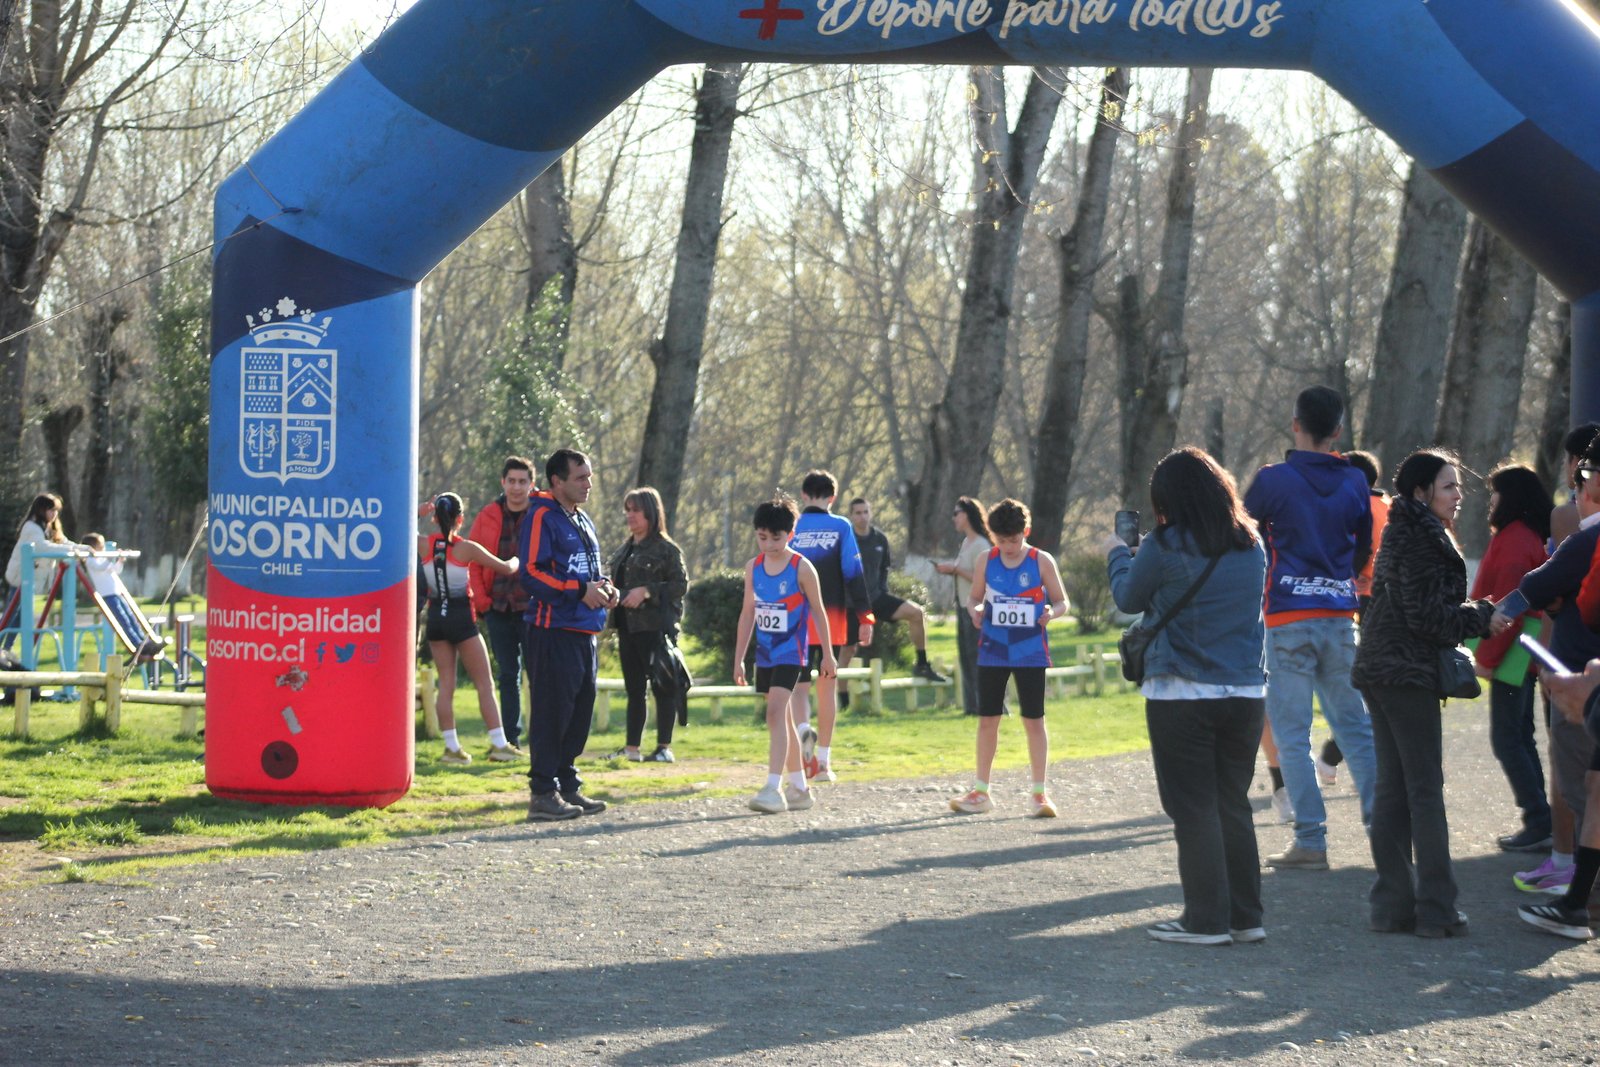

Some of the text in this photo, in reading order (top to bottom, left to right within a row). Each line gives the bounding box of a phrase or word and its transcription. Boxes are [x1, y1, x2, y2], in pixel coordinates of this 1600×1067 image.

[998, 0, 1117, 39] para
[295, 419, 316, 427] FIDE
[288, 465, 318, 474] AMORE
[210, 493, 383, 519] MUNICIPALIDAD
[210, 520, 382, 560] OSORNO
[261, 562, 303, 577] CHILE
[208, 604, 382, 636] municipalidad
[758, 614, 780, 629] 002
[998, 611, 1027, 625] 001
[208, 637, 305, 663] osorno.cl
